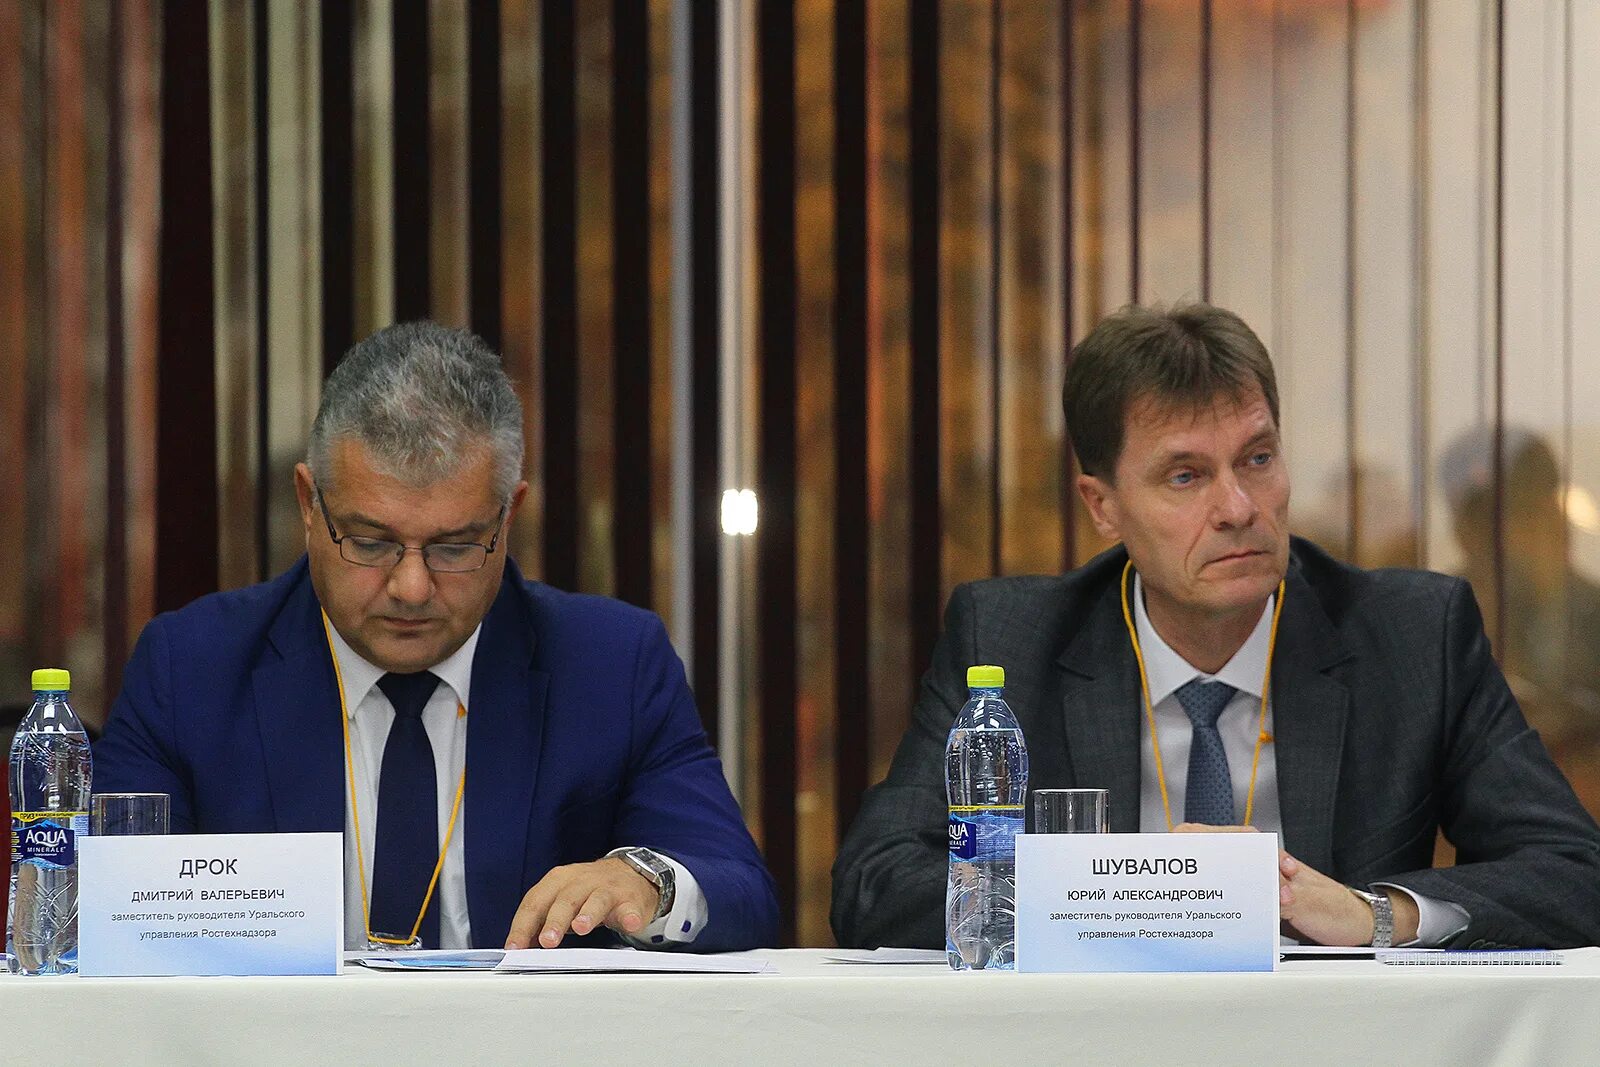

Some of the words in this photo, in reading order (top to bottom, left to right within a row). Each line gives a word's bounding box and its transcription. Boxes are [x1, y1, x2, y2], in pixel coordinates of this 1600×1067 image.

[25, 829, 68, 847] AQUA
[948, 823, 969, 840] QUA
[178, 859, 239, 878] ДРОК
[1092, 858, 1198, 875] ШУВАЛОВ
[131, 889, 194, 903] ДМИТРИЙ
[200, 889, 285, 901] ВАЛЕРЬЕВИЧ
[1067, 888, 1106, 901] ЮРИЙ
[1112, 889, 1224, 902] АЛЕКСАНДРОВИЧ
[111, 912, 175, 922] заместитель
[177, 911, 246, 923] руководителя
[249, 909, 305, 922] Уральского
[1049, 911, 1112, 921] заместитель
[1114, 911, 1183, 922] руководителя
[1186, 909, 1242, 922] Уральского
[139, 930, 199, 942] управления
[201, 928, 277, 941] Ростехнадзора
[1077, 929, 1136, 941] управления
[1138, 928, 1214, 940] Ростехнадзора
